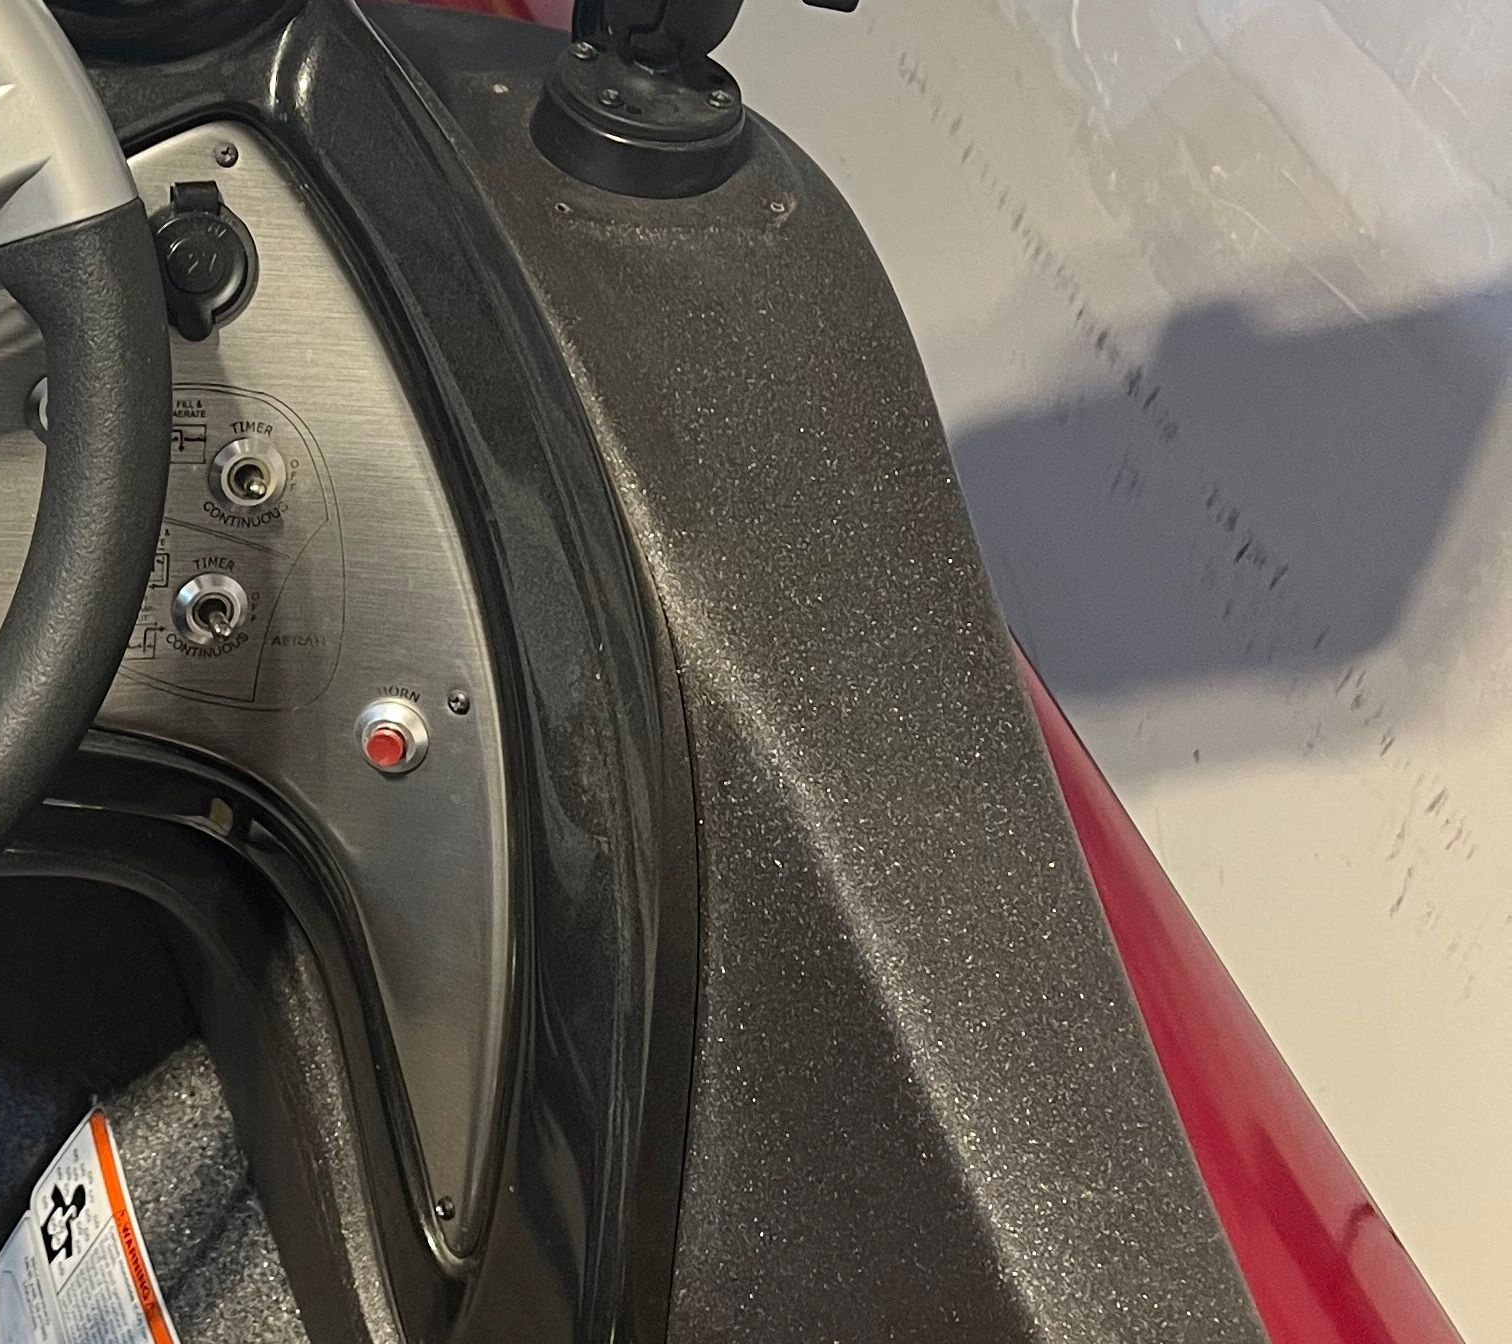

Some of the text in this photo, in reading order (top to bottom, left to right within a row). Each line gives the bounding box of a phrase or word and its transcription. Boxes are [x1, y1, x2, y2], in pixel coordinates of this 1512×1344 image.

[229, 421, 273, 437] TIMER
[203, 501, 289, 529] CONTINUOUS
[193, 557, 236, 571] TIMER
[166, 632, 249, 658] CONTINUOUS
[377, 685, 420, 703] HORN
